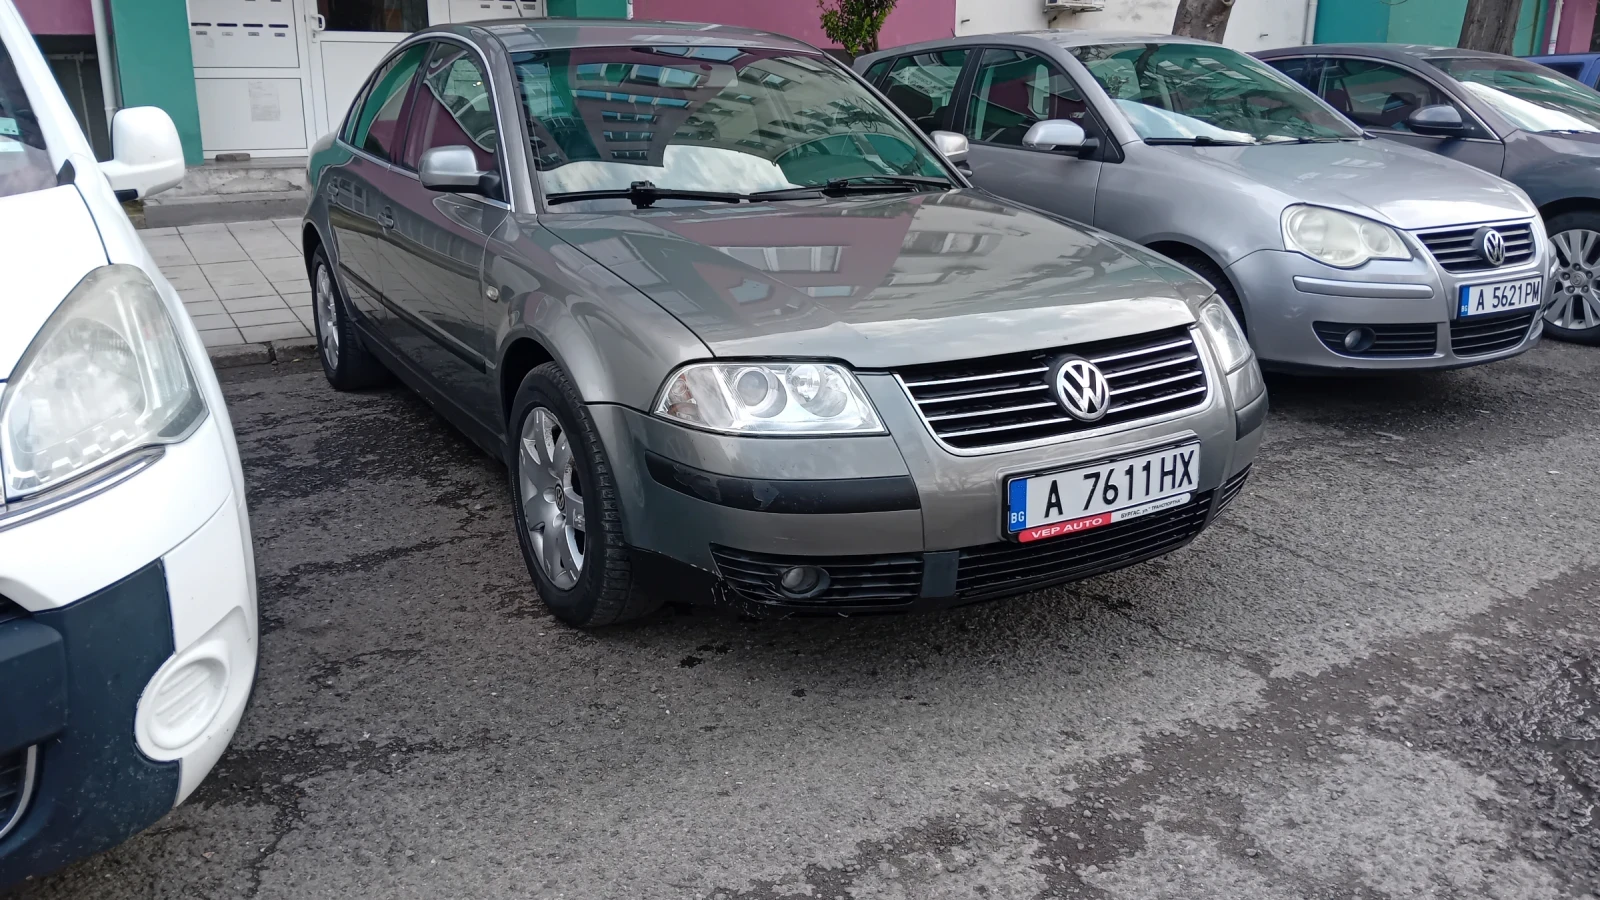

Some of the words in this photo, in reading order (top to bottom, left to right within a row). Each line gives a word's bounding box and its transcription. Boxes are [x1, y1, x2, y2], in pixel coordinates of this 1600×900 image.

[1476, 289, 1484, 311] A
[1056, 360, 1109, 420] VW
[1044, 480, 1064, 518] A
[1011, 511, 1025, 524] BG
[1032, 527, 1060, 538] VEP
[1063, 518, 1103, 532] AUTO
